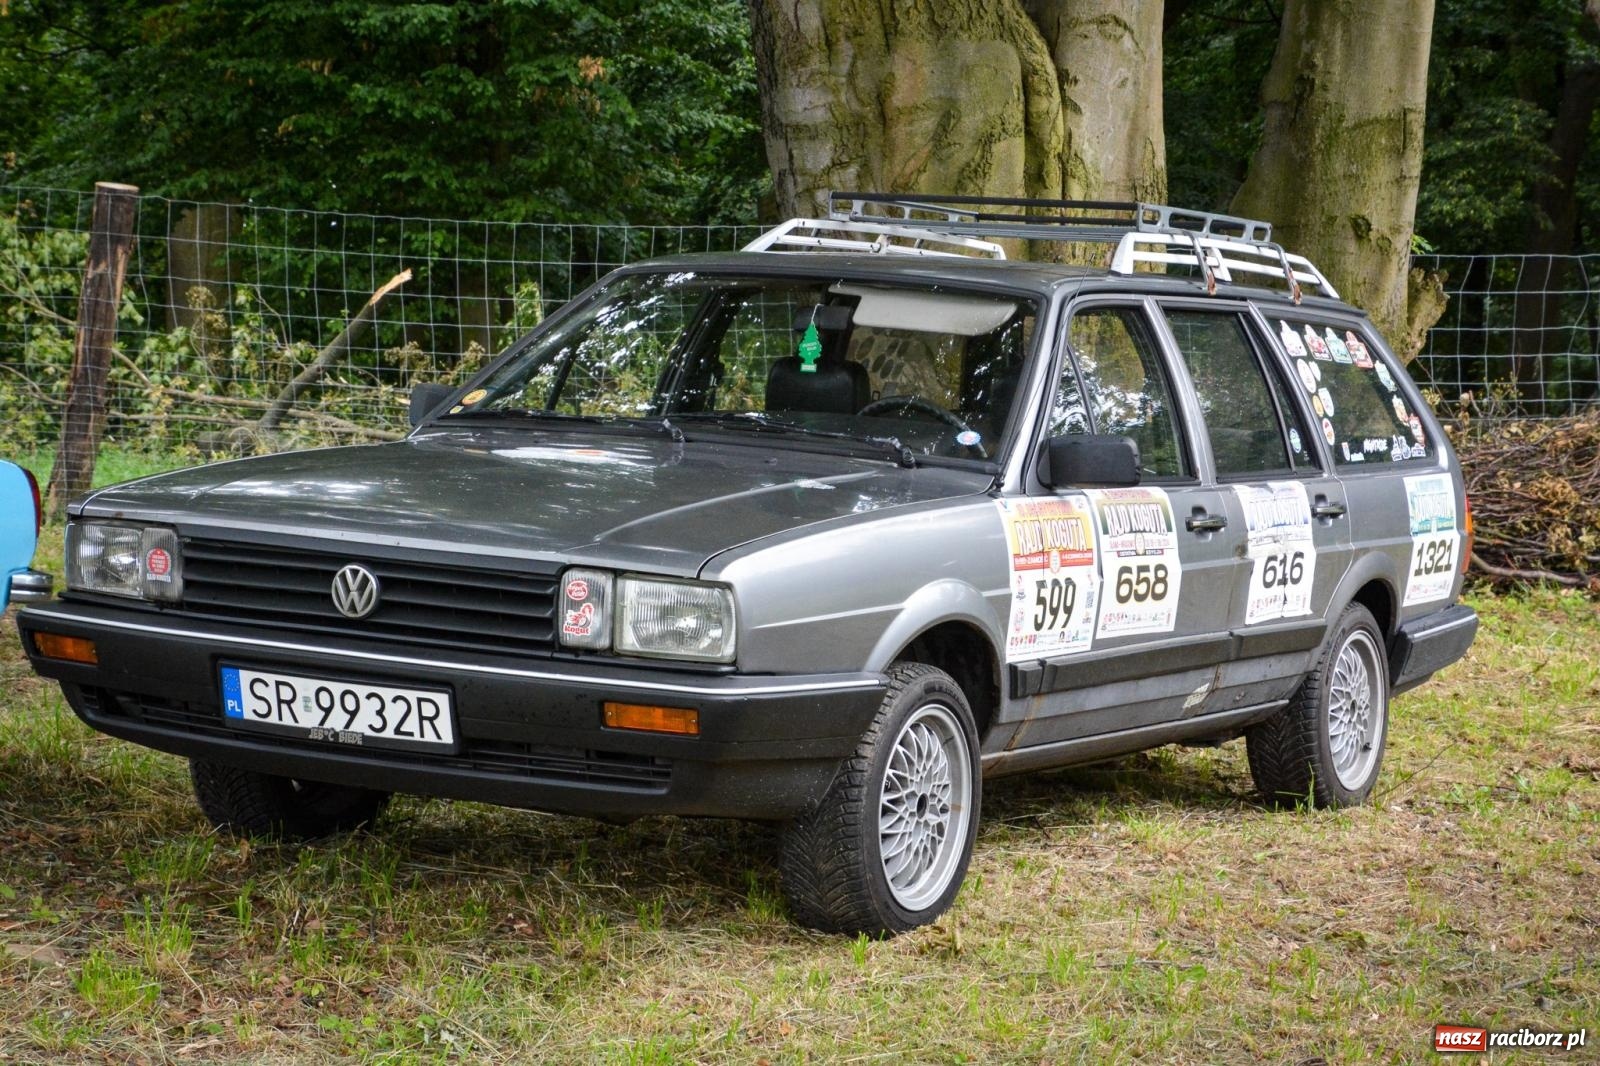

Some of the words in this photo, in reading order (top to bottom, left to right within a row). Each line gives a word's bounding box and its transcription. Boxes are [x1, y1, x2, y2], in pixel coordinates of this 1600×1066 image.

[1043, 517, 1087, 551] KOGUTA
[1262, 552, 1304, 589] 616
[1414, 538, 1453, 577] 1321
[1115, 563, 1169, 604] 658
[1034, 577, 1077, 632] 599
[227, 700, 241, 713] PL
[248, 677, 299, 724] SR
[314, 686, 443, 741] 9932R
